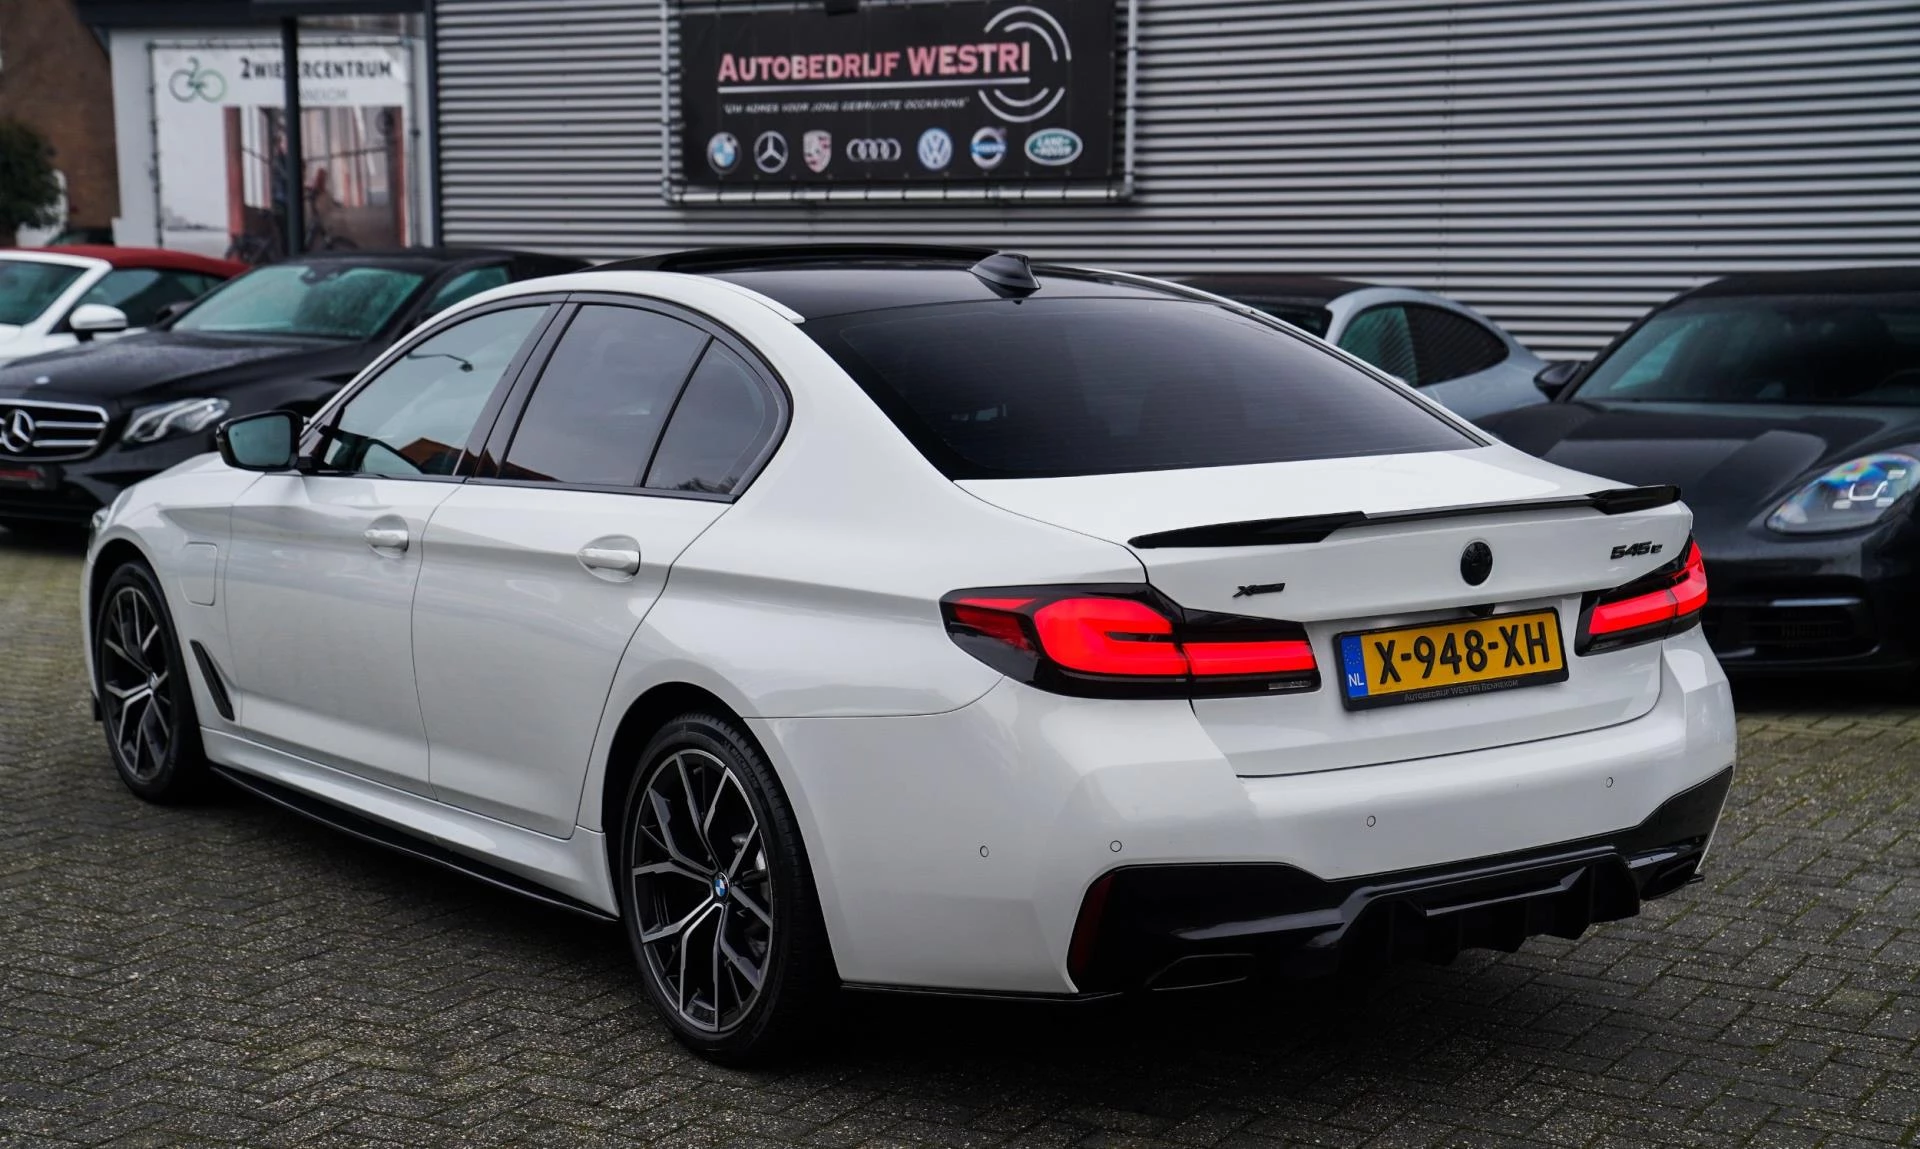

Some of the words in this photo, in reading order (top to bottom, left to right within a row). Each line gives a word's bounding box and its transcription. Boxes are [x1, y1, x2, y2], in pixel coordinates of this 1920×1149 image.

[240, 57, 391, 79] 2WIERCENTRUM
[718, 53, 901, 82] AUTOBEDRIJF
[906, 41, 1031, 76] WESTRI
[1374, 621, 1551, 685] X-948-XH
[1348, 673, 1365, 687] NL
